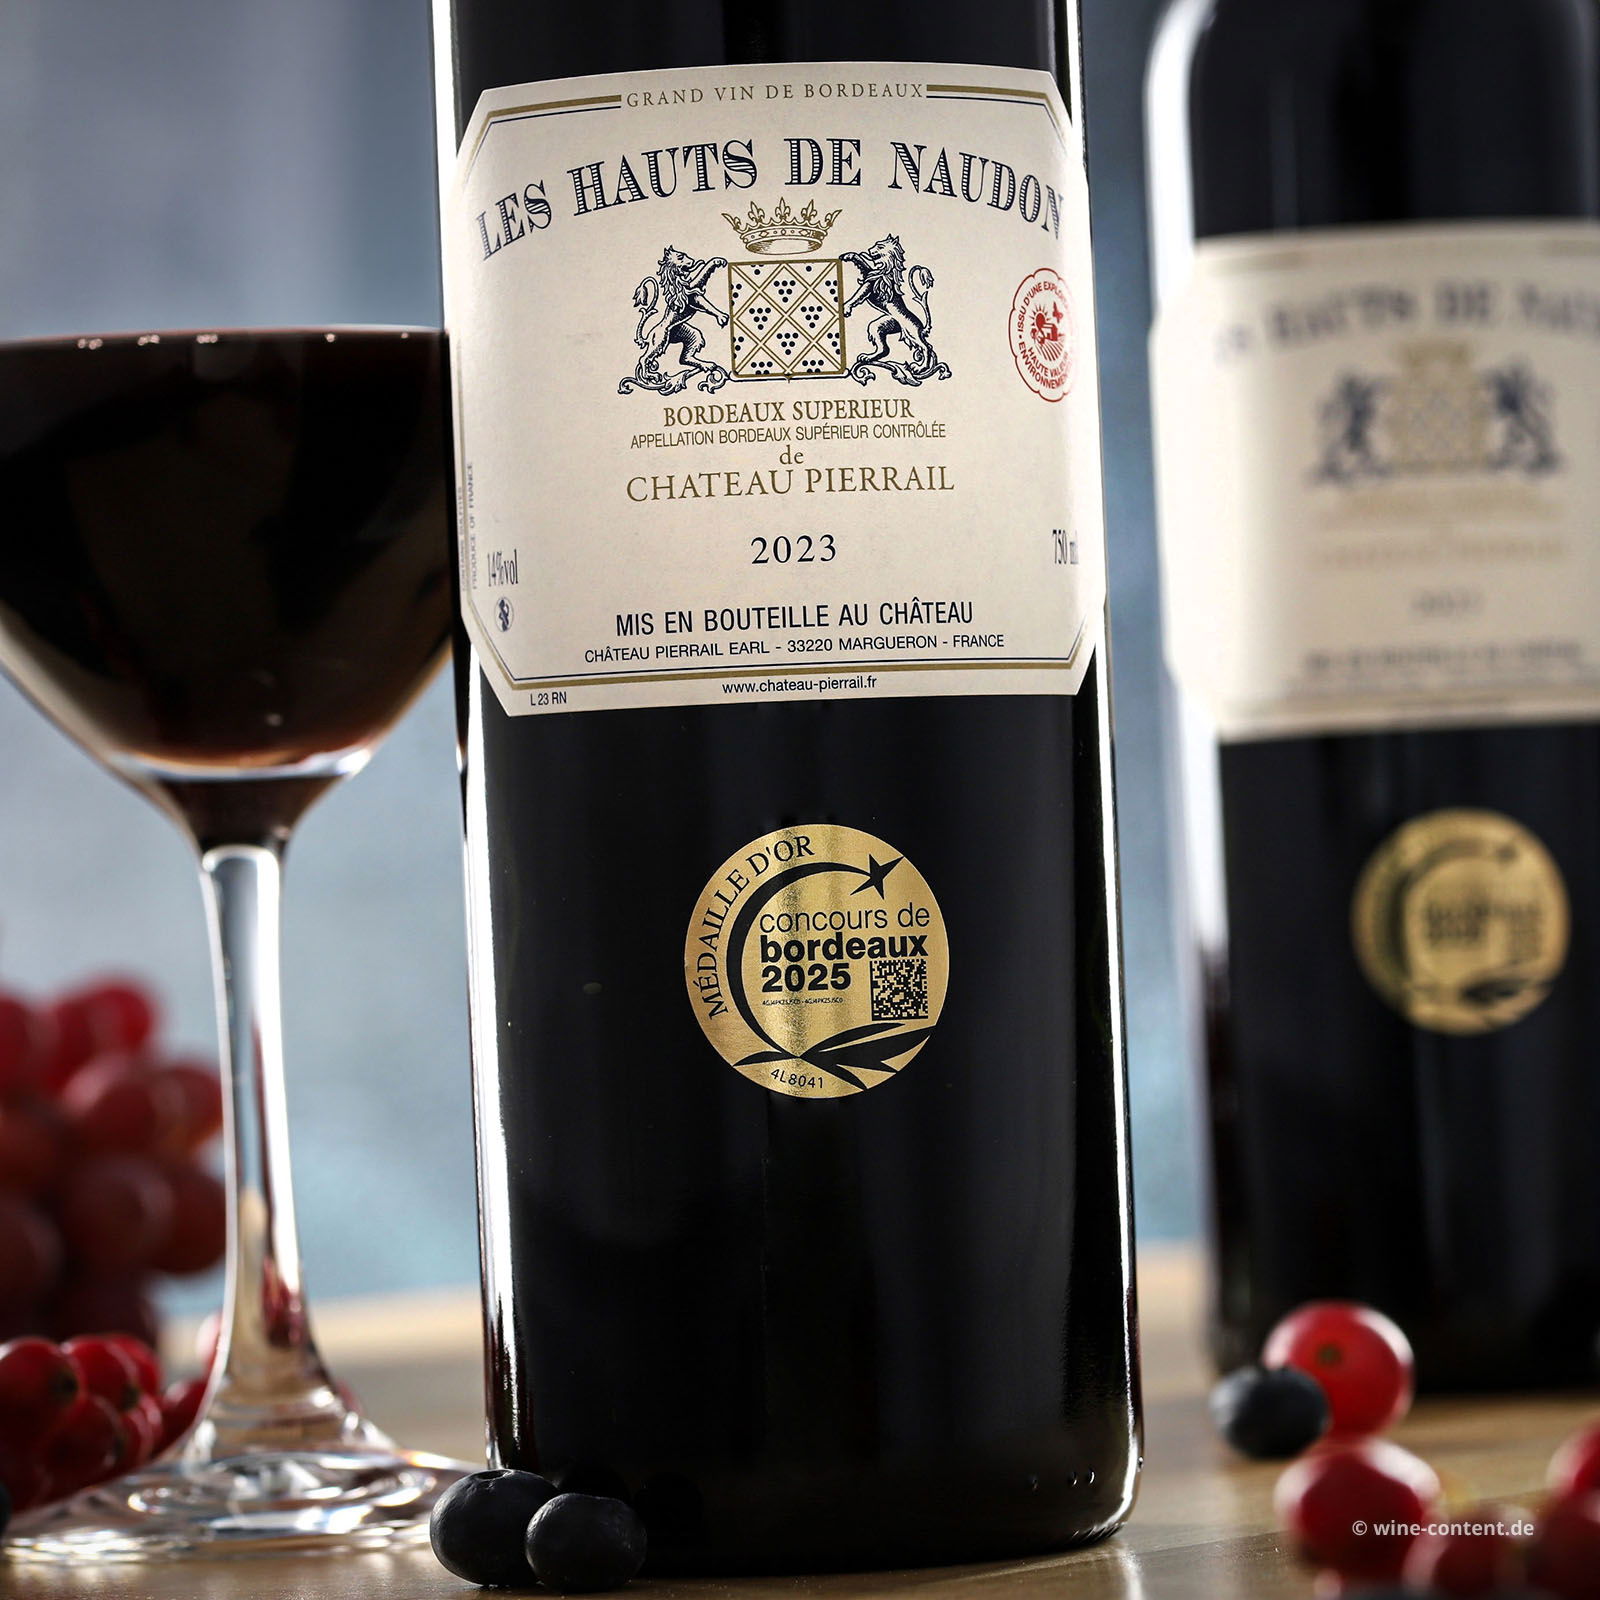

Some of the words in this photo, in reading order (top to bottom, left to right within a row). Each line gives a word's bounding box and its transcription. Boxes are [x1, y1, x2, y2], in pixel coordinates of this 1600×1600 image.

[626, 88, 704, 108] GRAND
[714, 85, 755, 101] VIN
[765, 84, 794, 99] DE
[804, 83, 923, 98] BORDEAUX
[475, 179, 553, 261] LES
[566, 139, 758, 217] HAUTS
[784, 138, 862, 186] DE
[887, 141, 1064, 240] NAUDON
[1017, 306, 1027, 332] ISSU
[1023, 282, 1042, 306] D'UNE
[1027, 347, 1049, 378] HAUTE
[663, 401, 785, 427] BORDEAUX
[792, 398, 915, 421] SUPERIEUR
[630, 429, 715, 449] APPELLATION
[718, 427, 791, 444] BORDEAUX
[795, 422, 869, 441] SUPÉRIEUR
[872, 420, 947, 438] CONTRÔLÉE
[779, 445, 804, 465] de
[626, 469, 794, 502] CHATEAU
[804, 465, 955, 493] PIERRAIL
[750, 534, 837, 565] 2023
[616, 612, 654, 637] MIS
[665, 610, 693, 634] EN
[704, 605, 829, 632] BOUTEILLE
[838, 603, 868, 627] AU
[879, 596, 973, 625] CHÂTEAU
[584, 646, 650, 663] CHÂTEAU
[655, 642, 724, 659] PIERRAIL
[729, 640, 770, 655] EARL
[787, 638, 833, 653] 33220
[838, 635, 938, 650] MARGUERON
[952, 634, 1005, 648] FRANCE
[530, 693, 536, 706] L
[537, 692, 549, 705] 23
[551, 691, 567, 704] RN
[722, 674, 877, 694] www.chateau-pierrail.fr
[693, 868, 751, 1021] MÉDAILLE
[745, 835, 816, 878] D'OR
[759, 908, 887, 934] concours
[897, 902, 930, 928] de
[760, 932, 929, 963] bordeaux
[761, 962, 852, 993] 2025
[769, 1067, 825, 1090] 4L8041
